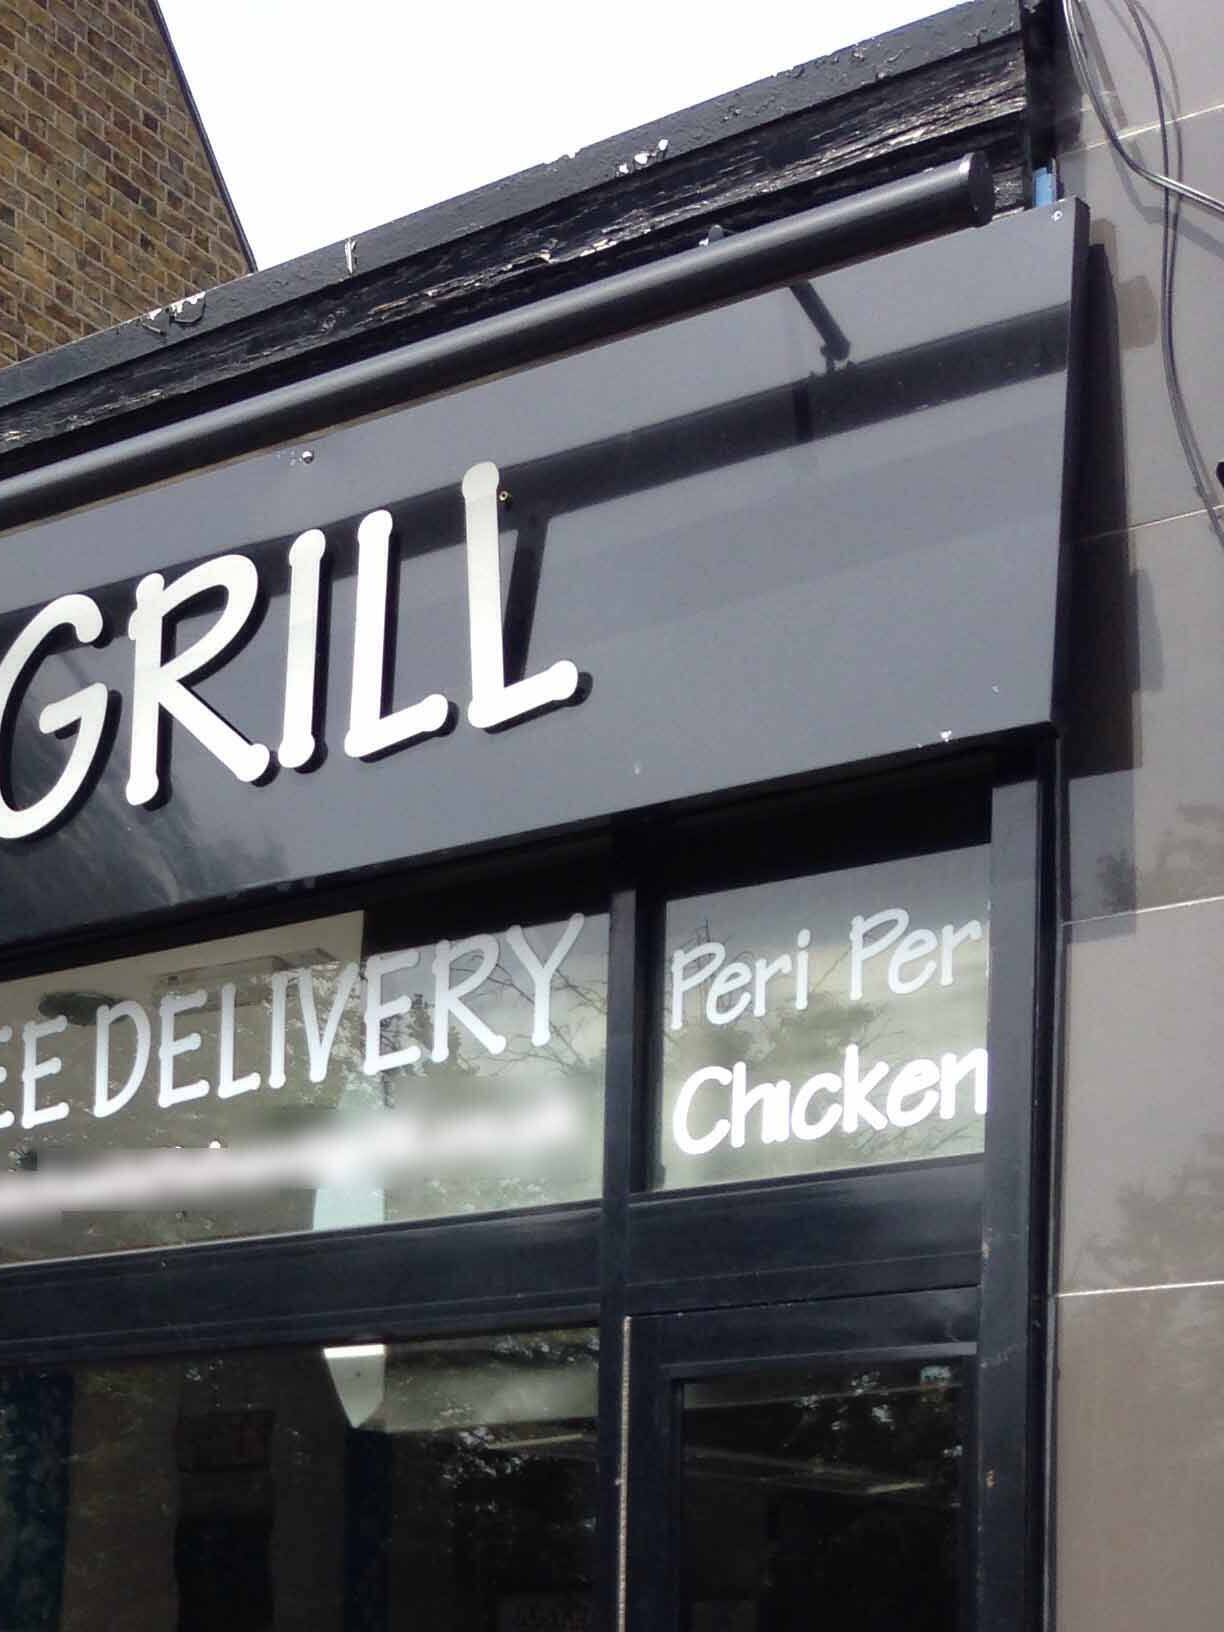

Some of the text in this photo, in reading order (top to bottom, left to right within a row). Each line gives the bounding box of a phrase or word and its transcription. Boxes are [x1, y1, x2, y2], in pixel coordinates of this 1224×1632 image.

[93, 913, 585, 1111] DELIVERY
[669, 929, 811, 1029] Peri
[673, 1044, 988, 1155] Chicken
